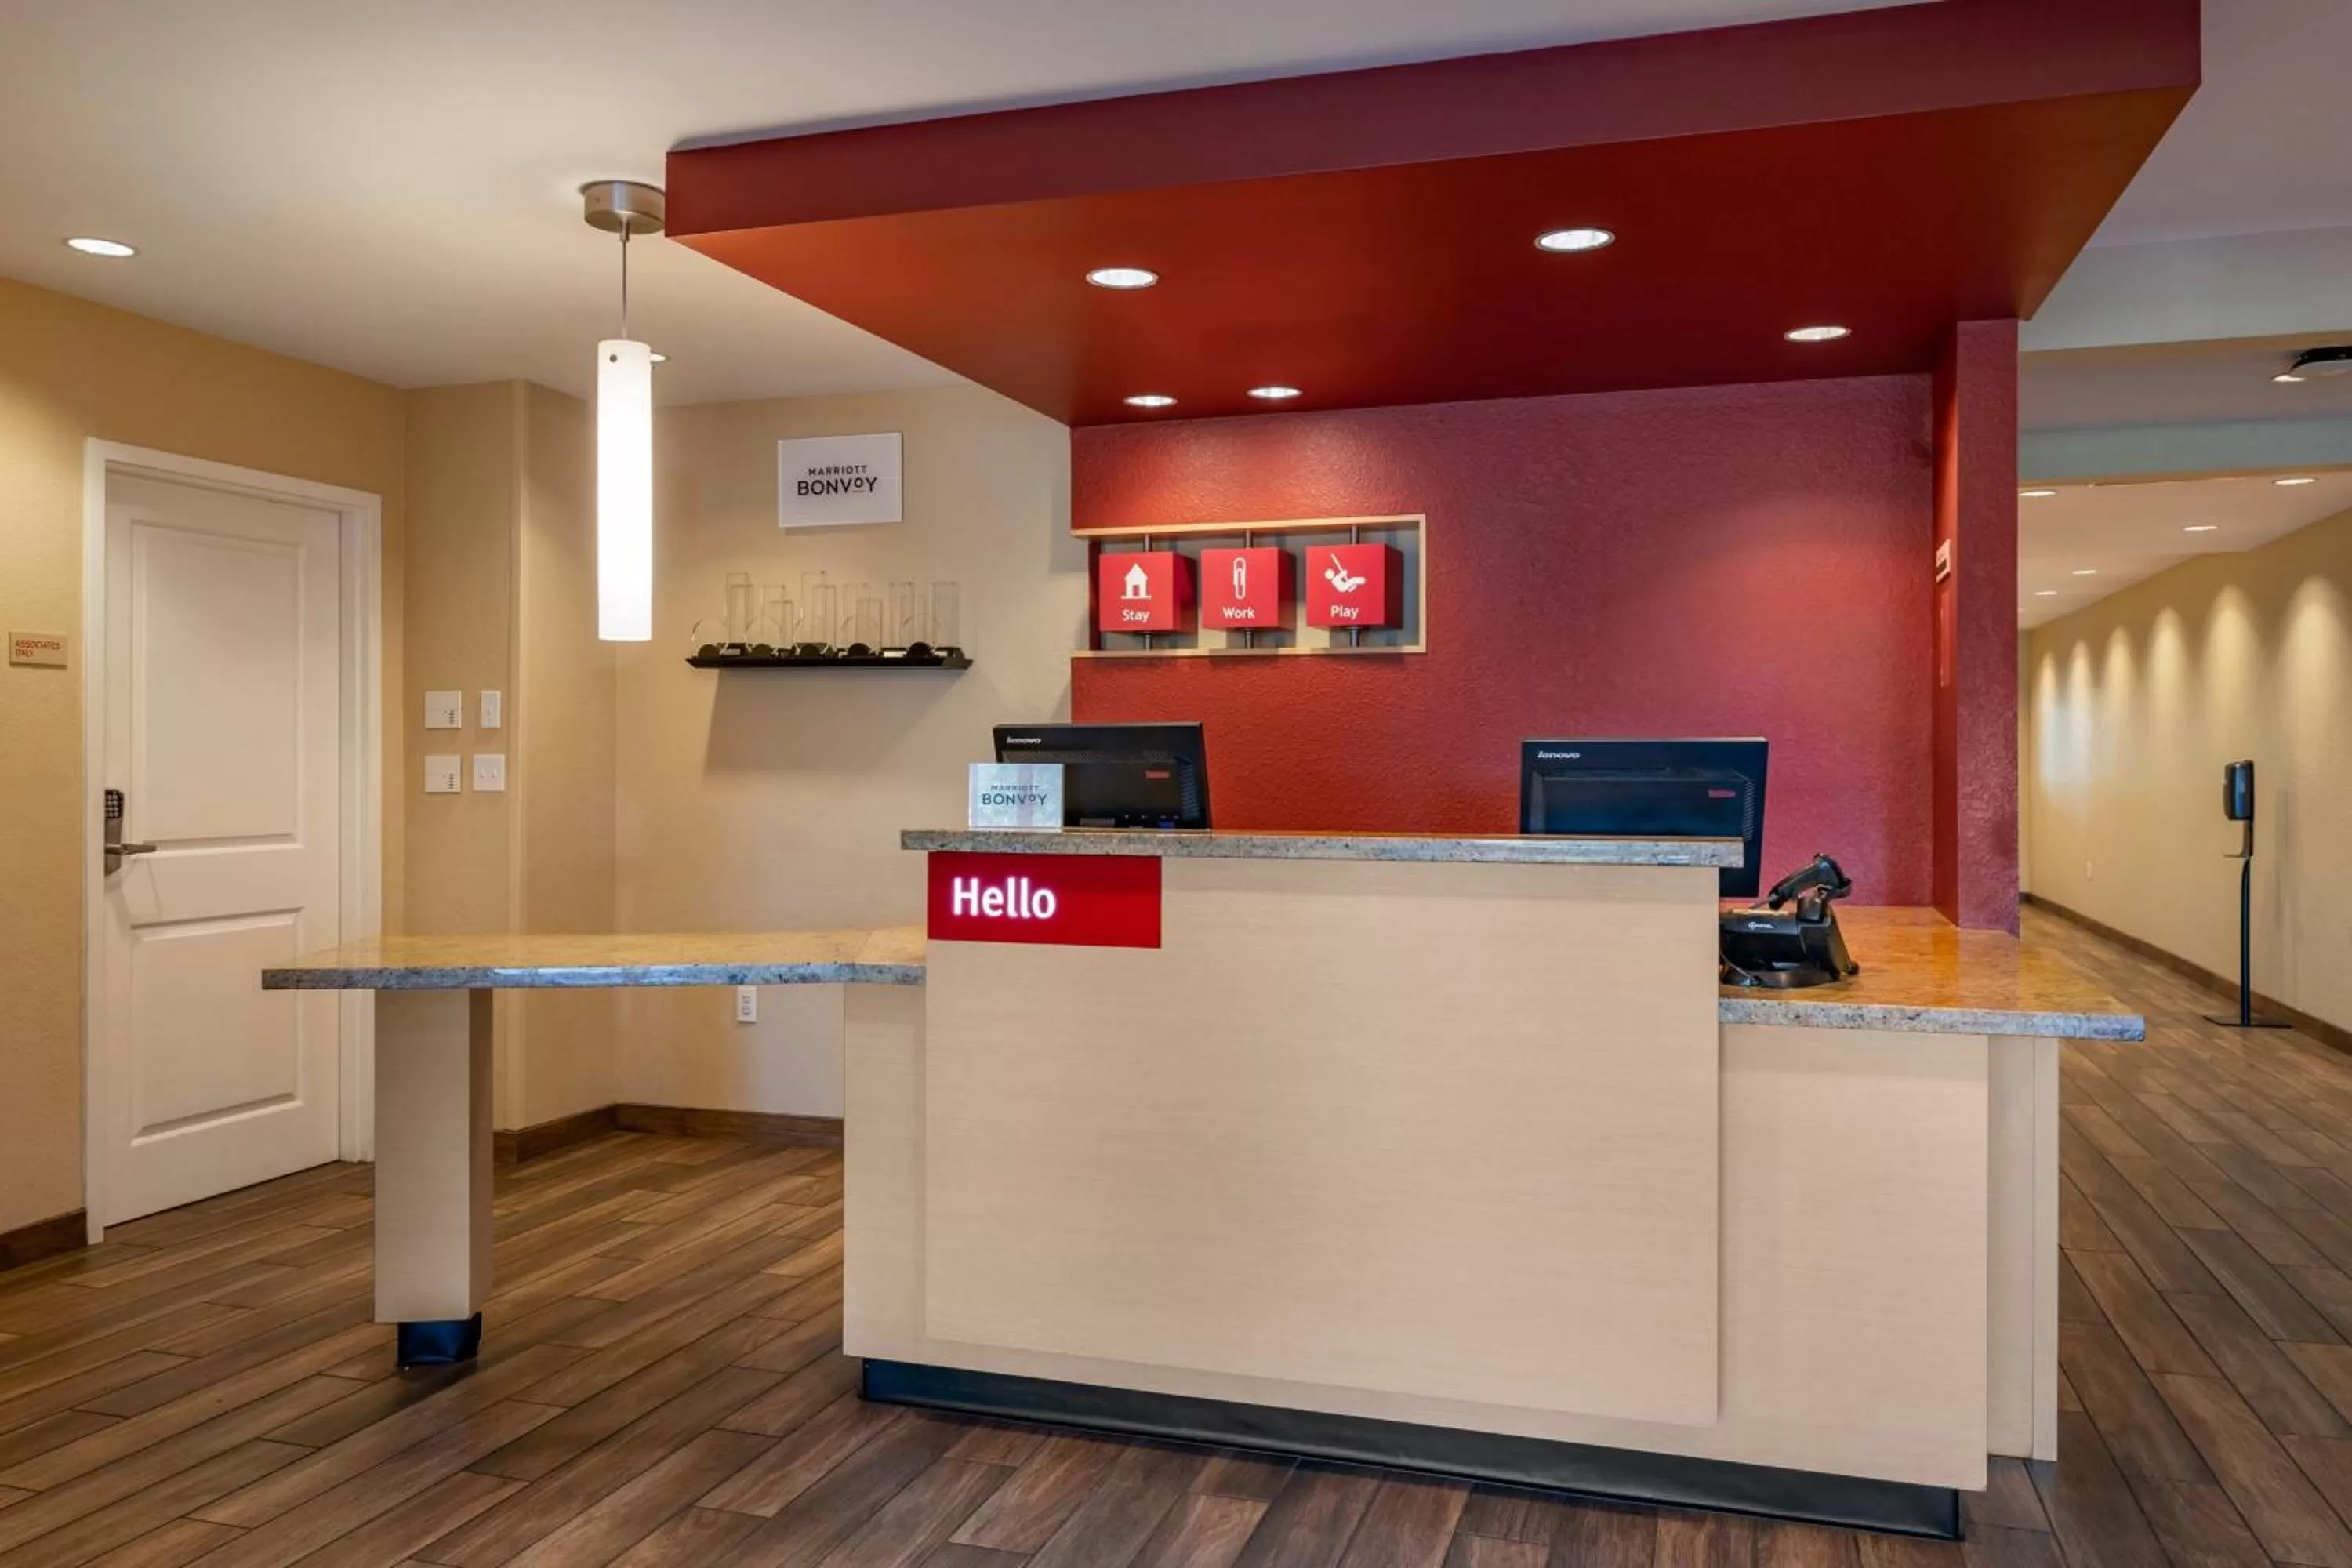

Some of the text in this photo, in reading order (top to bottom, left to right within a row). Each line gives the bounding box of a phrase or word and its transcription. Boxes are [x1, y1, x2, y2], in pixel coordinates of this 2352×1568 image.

[808, 464, 867, 476] MARRIOTT
[797, 477, 878, 495] BONVOY
[1122, 608, 1150, 622] Stay
[1223, 605, 1256, 619] Work
[1330, 604, 1359, 619] Play
[982, 793, 1047, 805] BONVOY
[953, 877, 1056, 919] Hello
